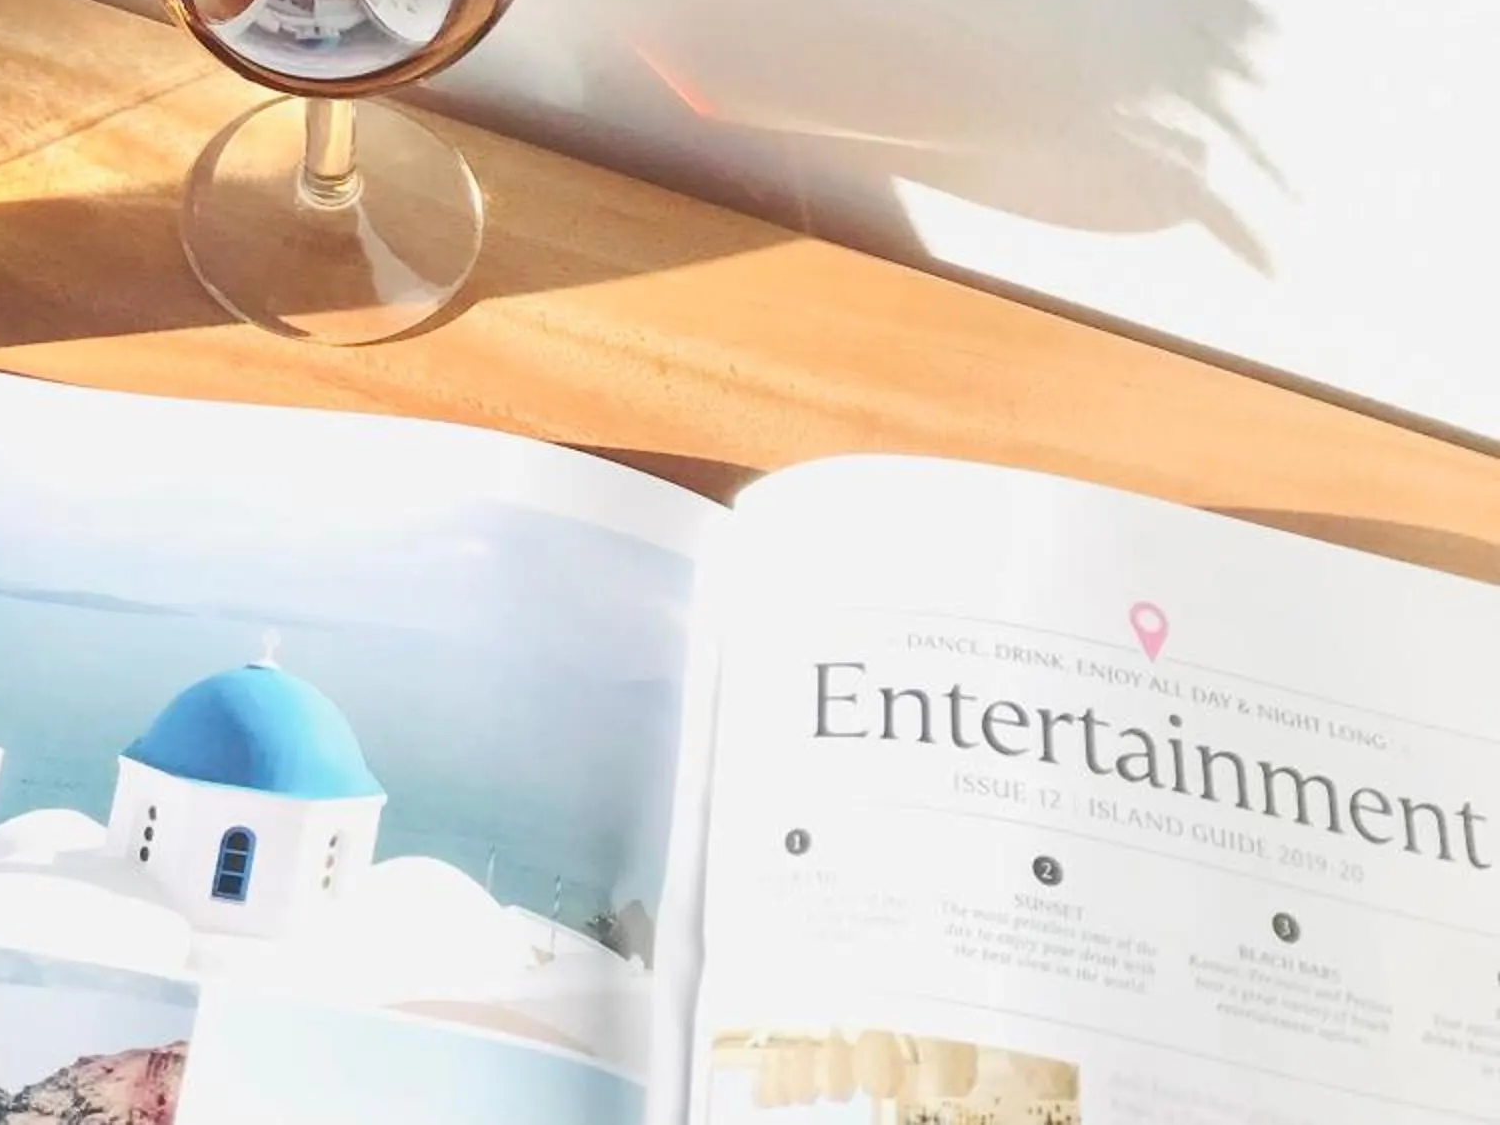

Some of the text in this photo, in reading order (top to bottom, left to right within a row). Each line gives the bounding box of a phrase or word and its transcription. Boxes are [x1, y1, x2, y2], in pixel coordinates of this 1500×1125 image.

[1149, 675, 1182, 698] ALL
[1192, 685, 1233, 709] DAY
[1237, 698, 1251, 715] &
[1256, 703, 1320, 734] NIGHT
[1328, 720, 1387, 750] LONG
[812, 660, 1493, 870] Entertainment
[953, 771, 1027, 805] ISSUE
[1038, 787, 1061, 810] 12
[1088, 796, 1185, 838] ISLAND
[1192, 823, 1274, 859] GUIDE
[1013, 892, 1084, 923] SUNSET
